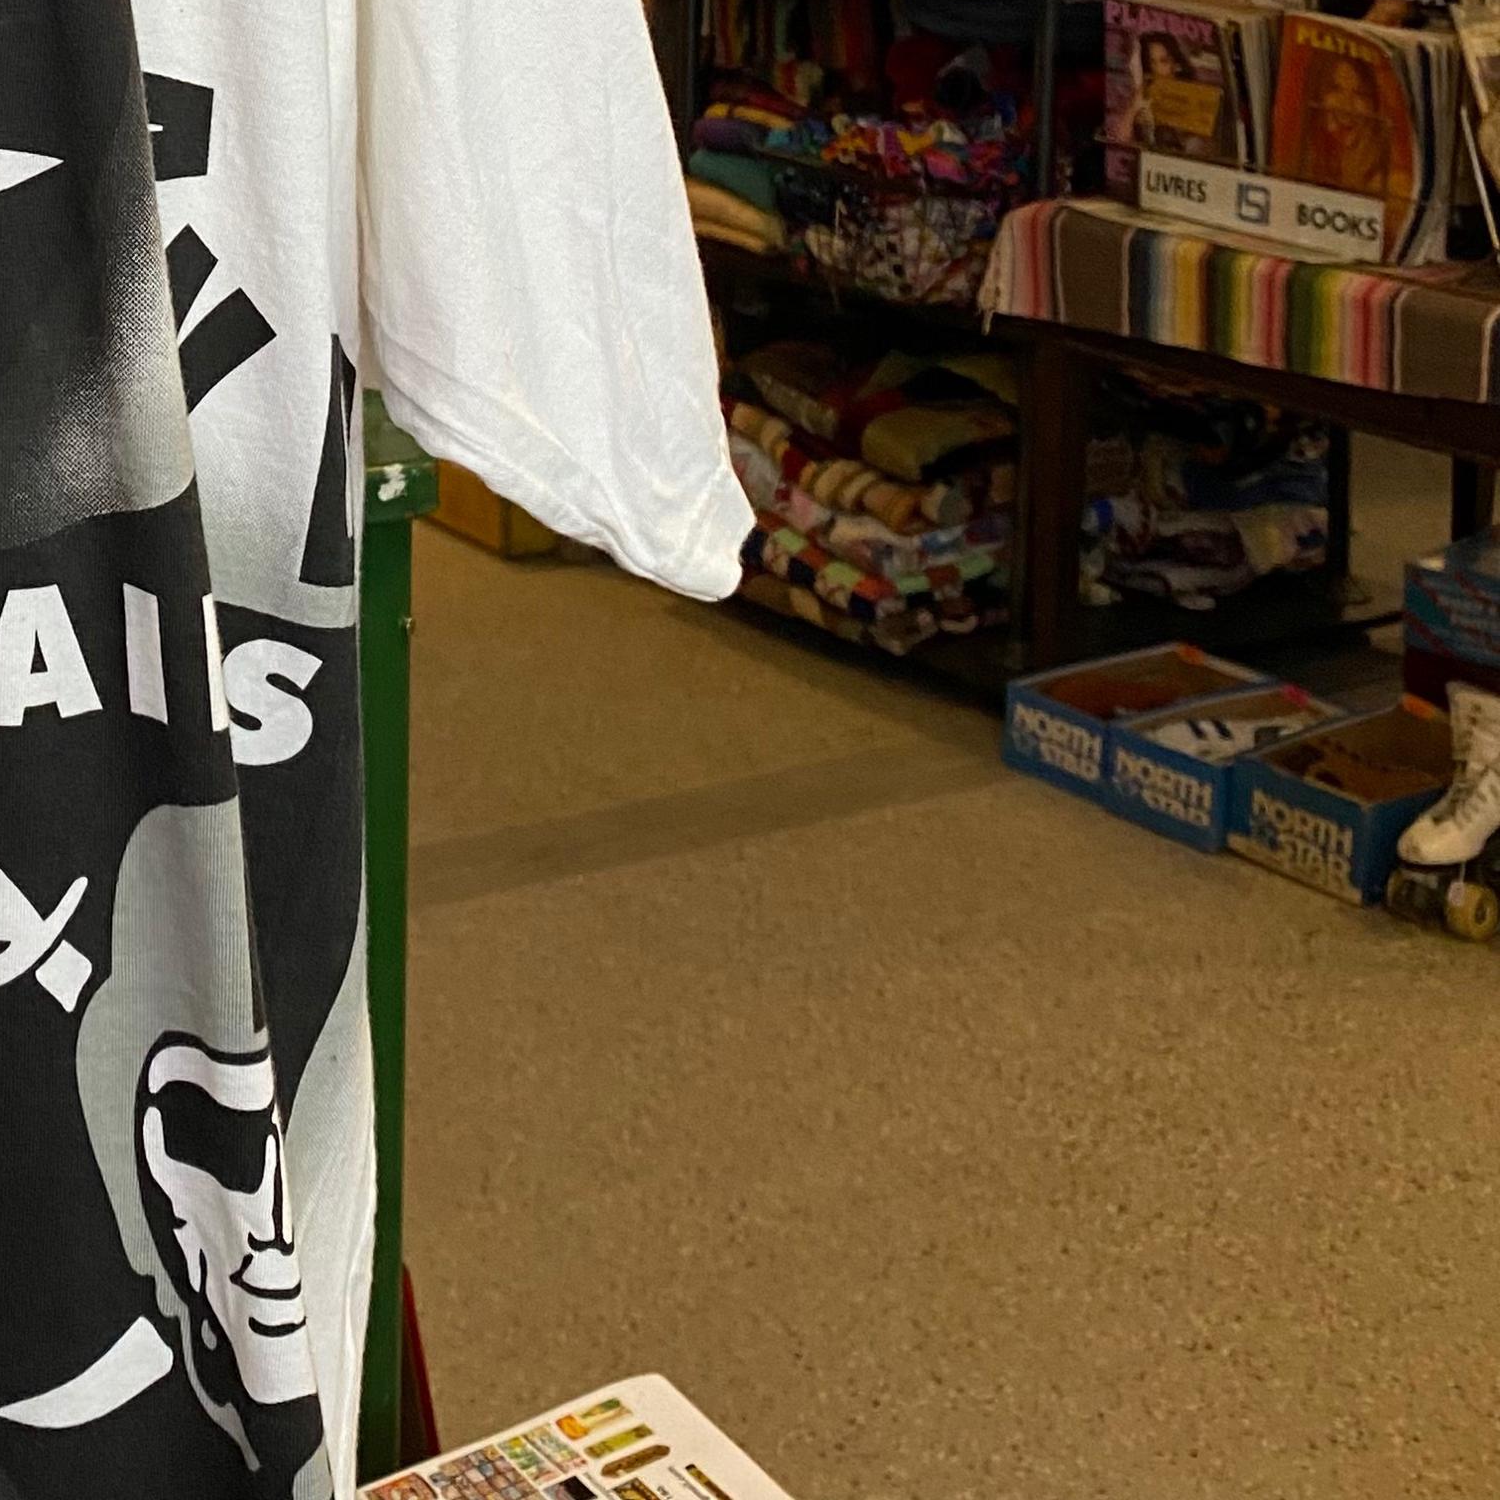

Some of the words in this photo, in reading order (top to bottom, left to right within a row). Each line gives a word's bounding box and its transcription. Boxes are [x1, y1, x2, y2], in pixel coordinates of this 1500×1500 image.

[1104, 0, 1218, 45] PLAYBOY
[1146, 170, 1207, 203] LIVRES
[1296, 203, 1379, 241] BOOKS
[1251, 787, 1353, 857] NORTH
